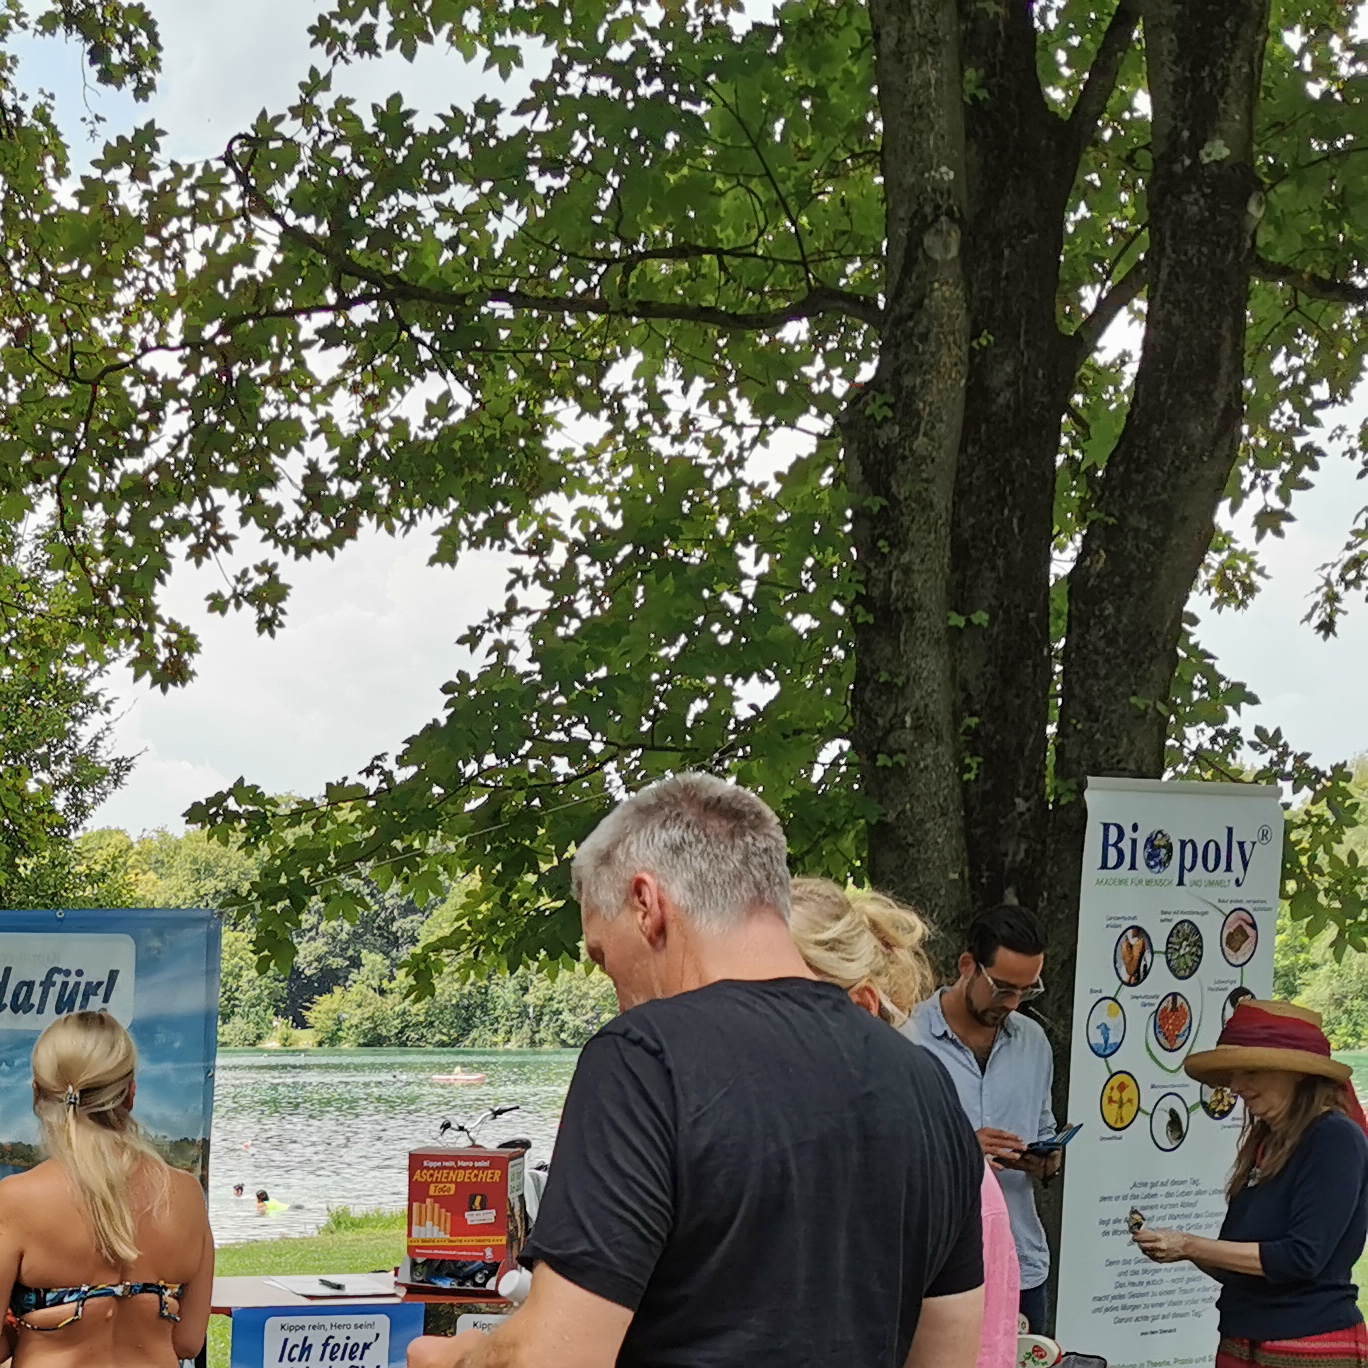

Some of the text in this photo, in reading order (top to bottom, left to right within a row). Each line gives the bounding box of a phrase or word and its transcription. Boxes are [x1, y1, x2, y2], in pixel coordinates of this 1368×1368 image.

[412, 1169, 502, 1182] ASCHENBECHER
[280, 1321, 376, 1332] Kippe rein, Hero sein!
[278, 1336, 312, 1364] Ich
